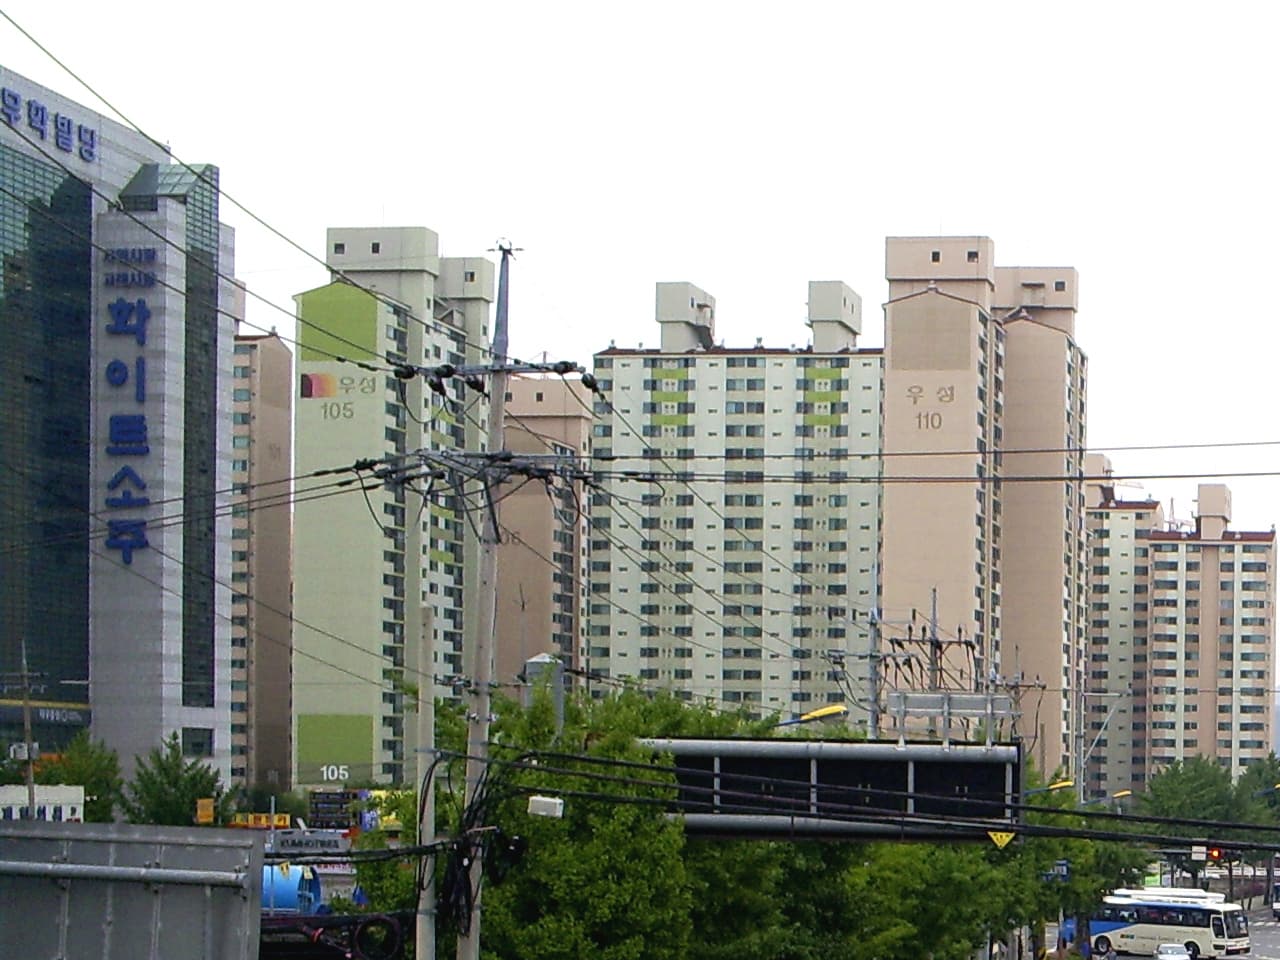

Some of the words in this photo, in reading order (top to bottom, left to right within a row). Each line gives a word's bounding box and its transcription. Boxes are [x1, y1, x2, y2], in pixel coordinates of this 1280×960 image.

[339, 376, 376, 394] 우성
[906, 385, 955, 405] 우성
[321, 402, 354, 420] 105
[915, 411, 942, 430] 110
[105, 298, 151, 565] 화이트소주
[320, 765, 349, 781] 105
